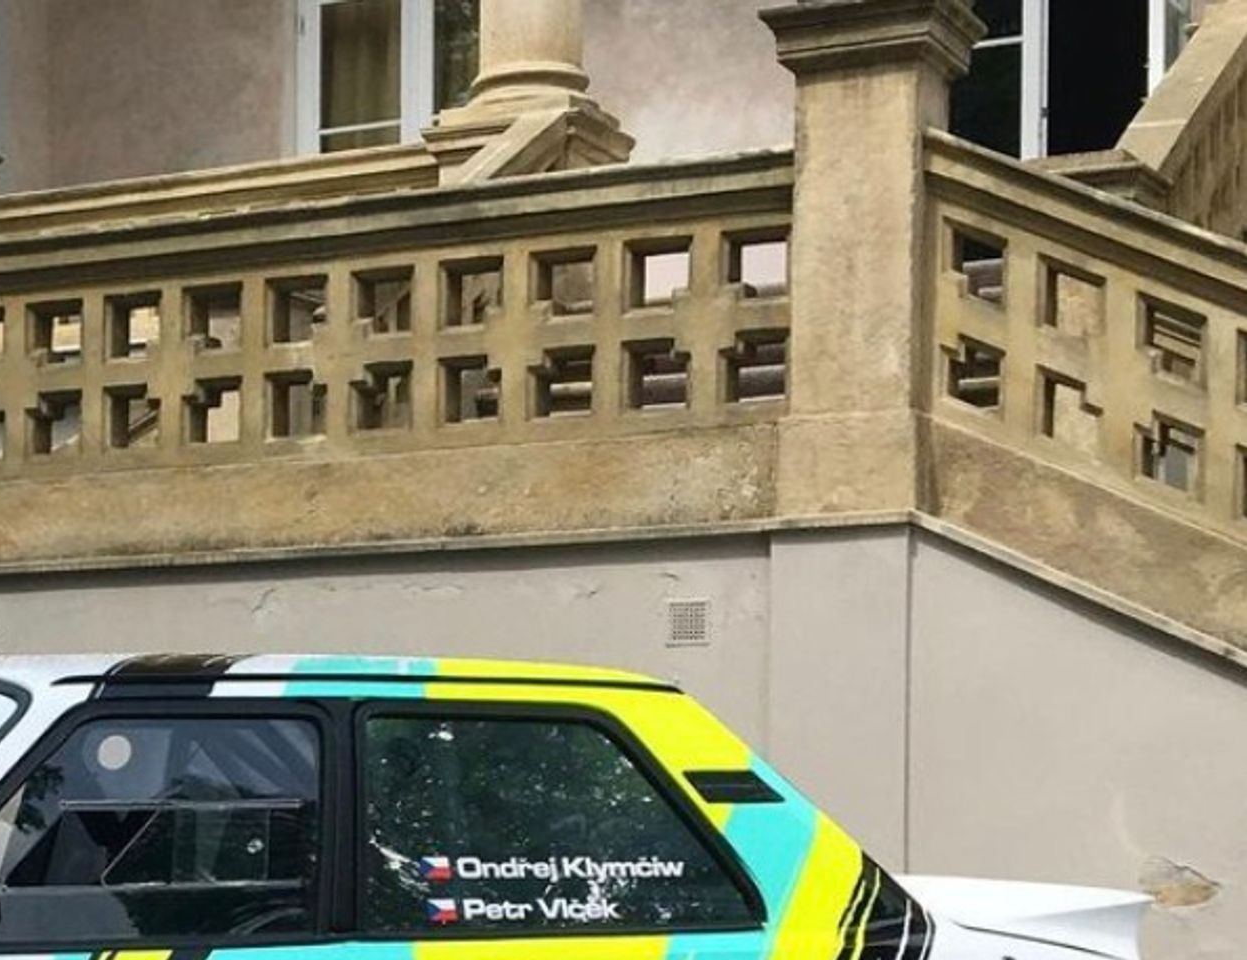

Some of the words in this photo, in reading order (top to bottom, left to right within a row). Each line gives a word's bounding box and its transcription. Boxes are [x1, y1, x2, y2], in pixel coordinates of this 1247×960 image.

[456, 856, 557, 883] Ondřej
[562, 856, 684, 883] Klymčiw
[463, 899, 533, 920] Petr
[537, 898, 621, 921] Vlček
